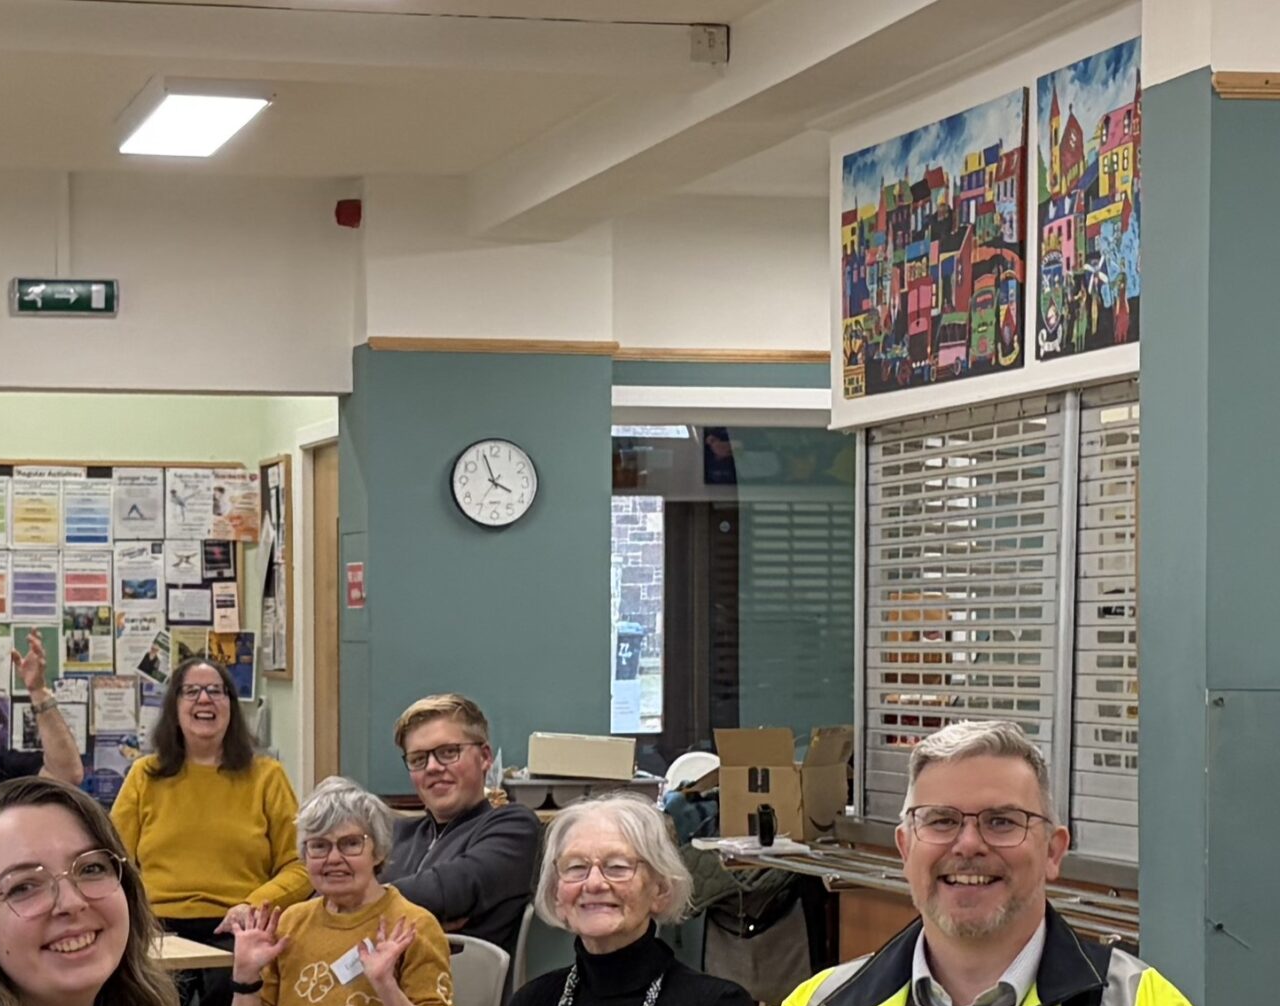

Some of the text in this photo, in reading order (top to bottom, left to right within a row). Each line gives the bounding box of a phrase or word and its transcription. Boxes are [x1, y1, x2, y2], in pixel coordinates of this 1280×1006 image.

[489, 445, 500, 458] 12
[464, 461, 478, 474] 10
[516, 461, 526, 474] 2
[459, 475, 469, 487] 9
[522, 476, 529, 489] 3
[463, 491, 472, 505] 8
[489, 510, 500, 521] 6
[506, 503, 515, 516] 5
